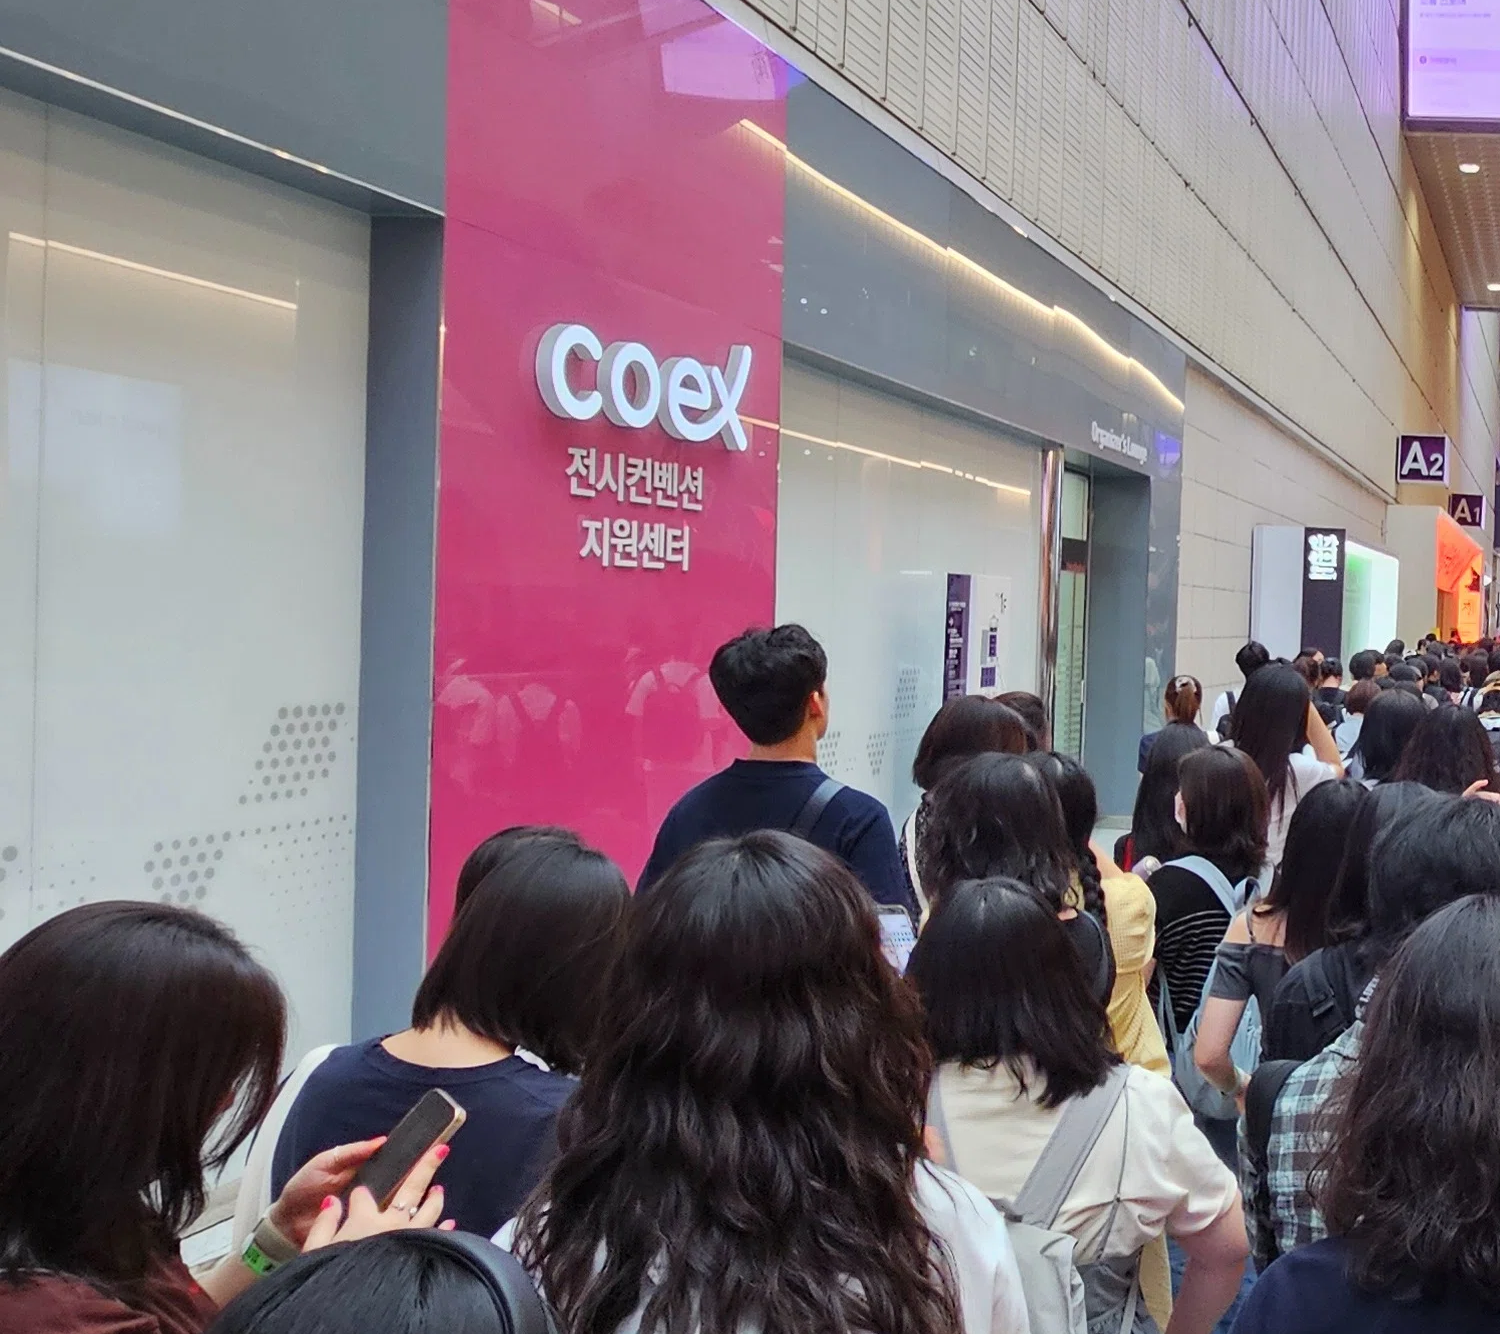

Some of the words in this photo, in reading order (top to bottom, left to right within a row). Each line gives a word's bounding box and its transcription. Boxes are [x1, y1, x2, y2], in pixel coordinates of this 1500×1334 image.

[536, 323, 752, 451] coex
[565, 447, 704, 511] 전시컨벤션
[1400, 440, 1443, 477] A2
[1453, 497, 1481, 524] A1
[579, 518, 690, 572] 지원센터
